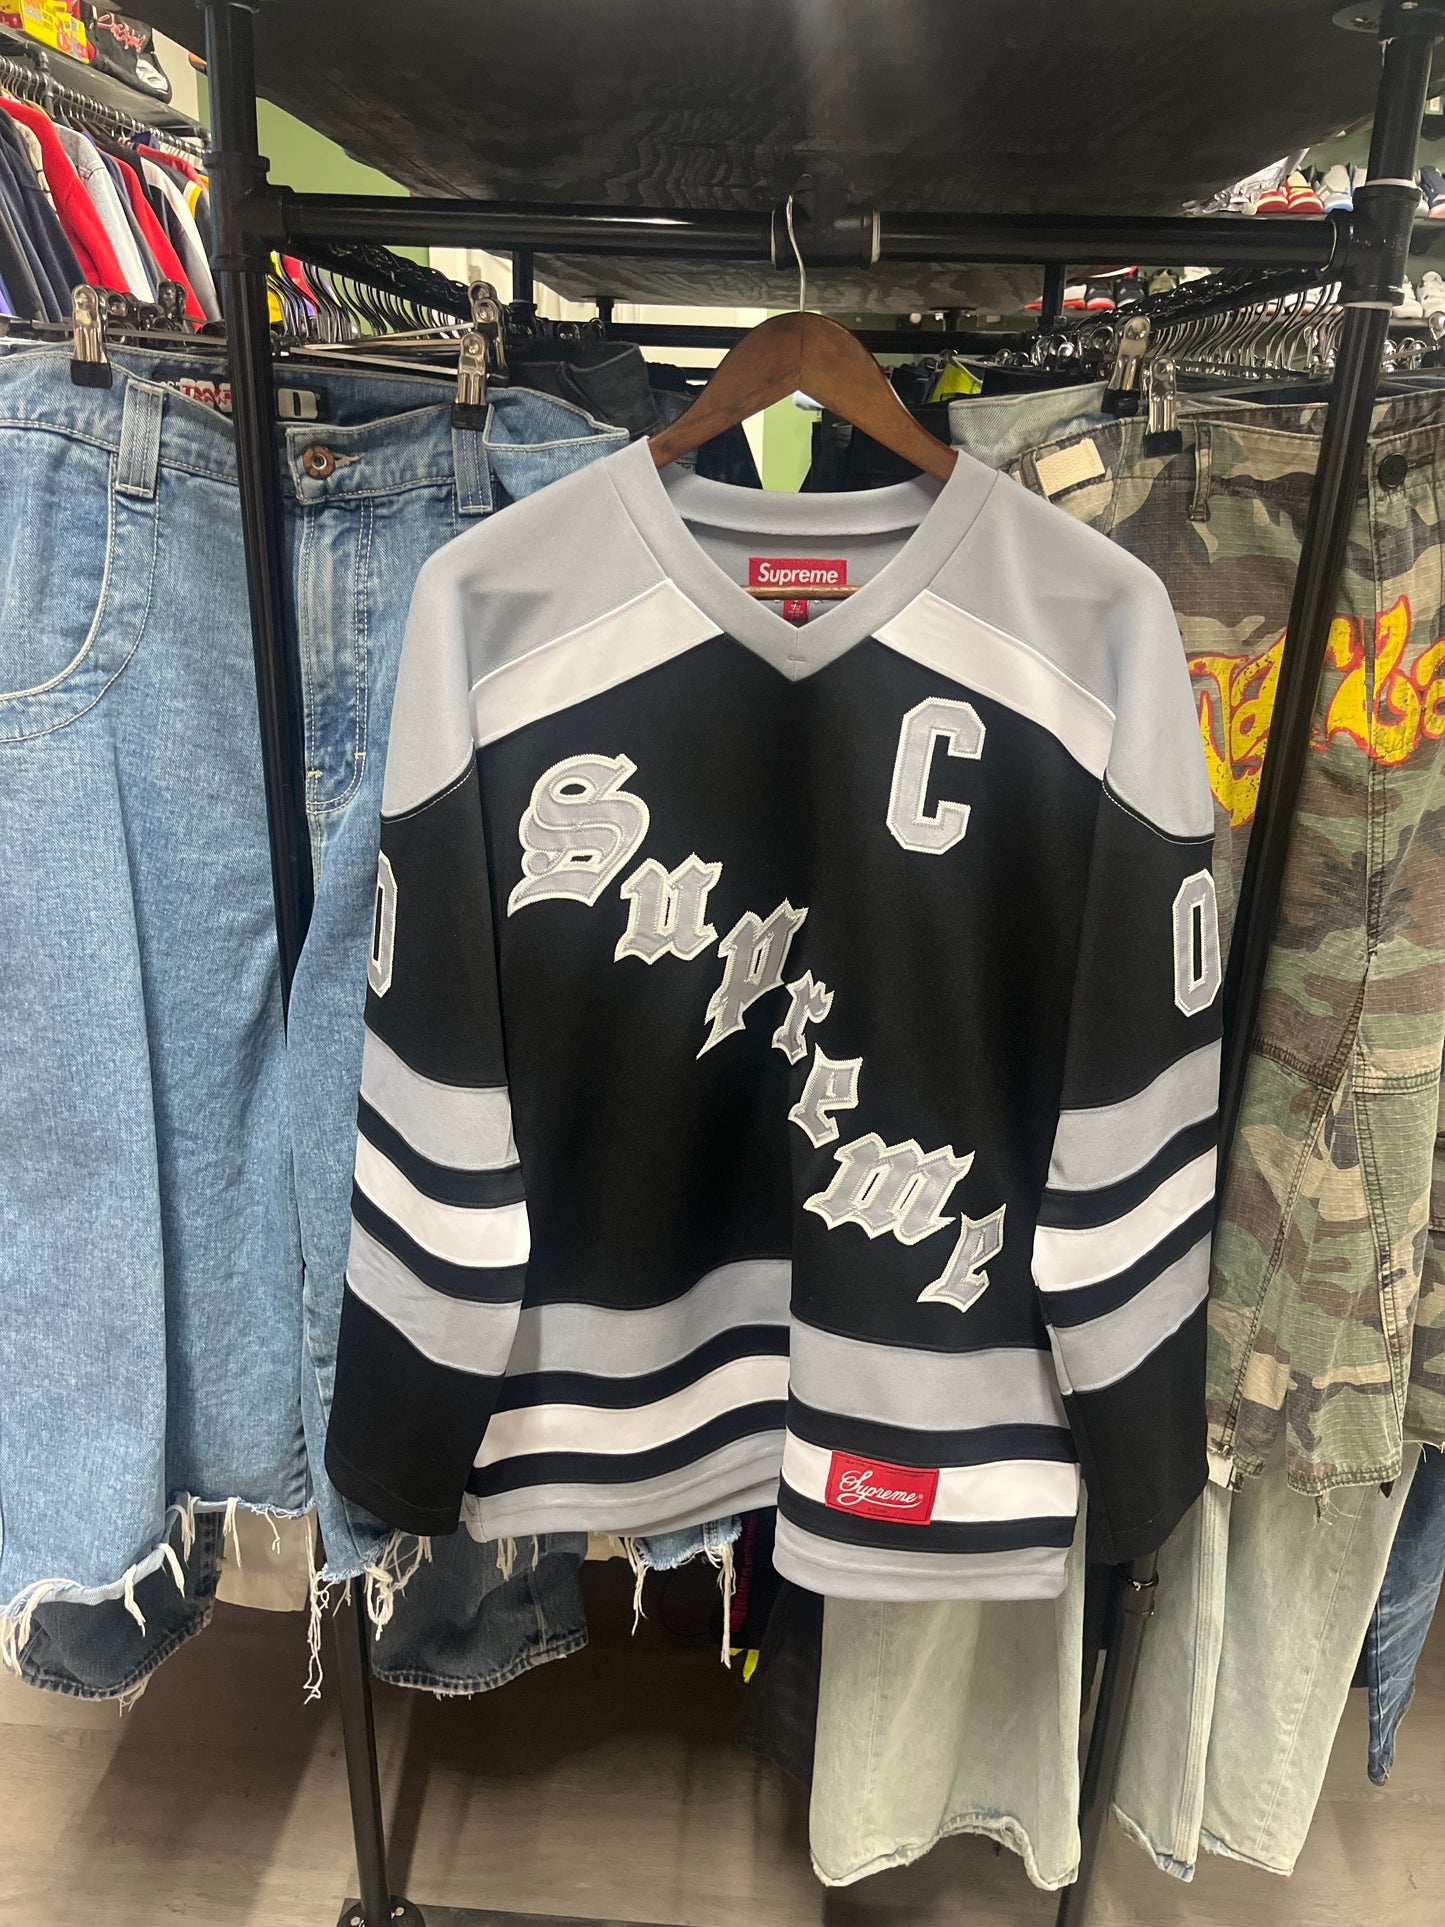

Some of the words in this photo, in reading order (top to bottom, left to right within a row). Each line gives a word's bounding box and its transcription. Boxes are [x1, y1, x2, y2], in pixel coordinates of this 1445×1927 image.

[758, 562, 839, 586] Supreme
[886, 696, 986, 855] C
[507, 753, 1007, 1313] Supreme
[837, 1470, 922, 1508] Supreme
